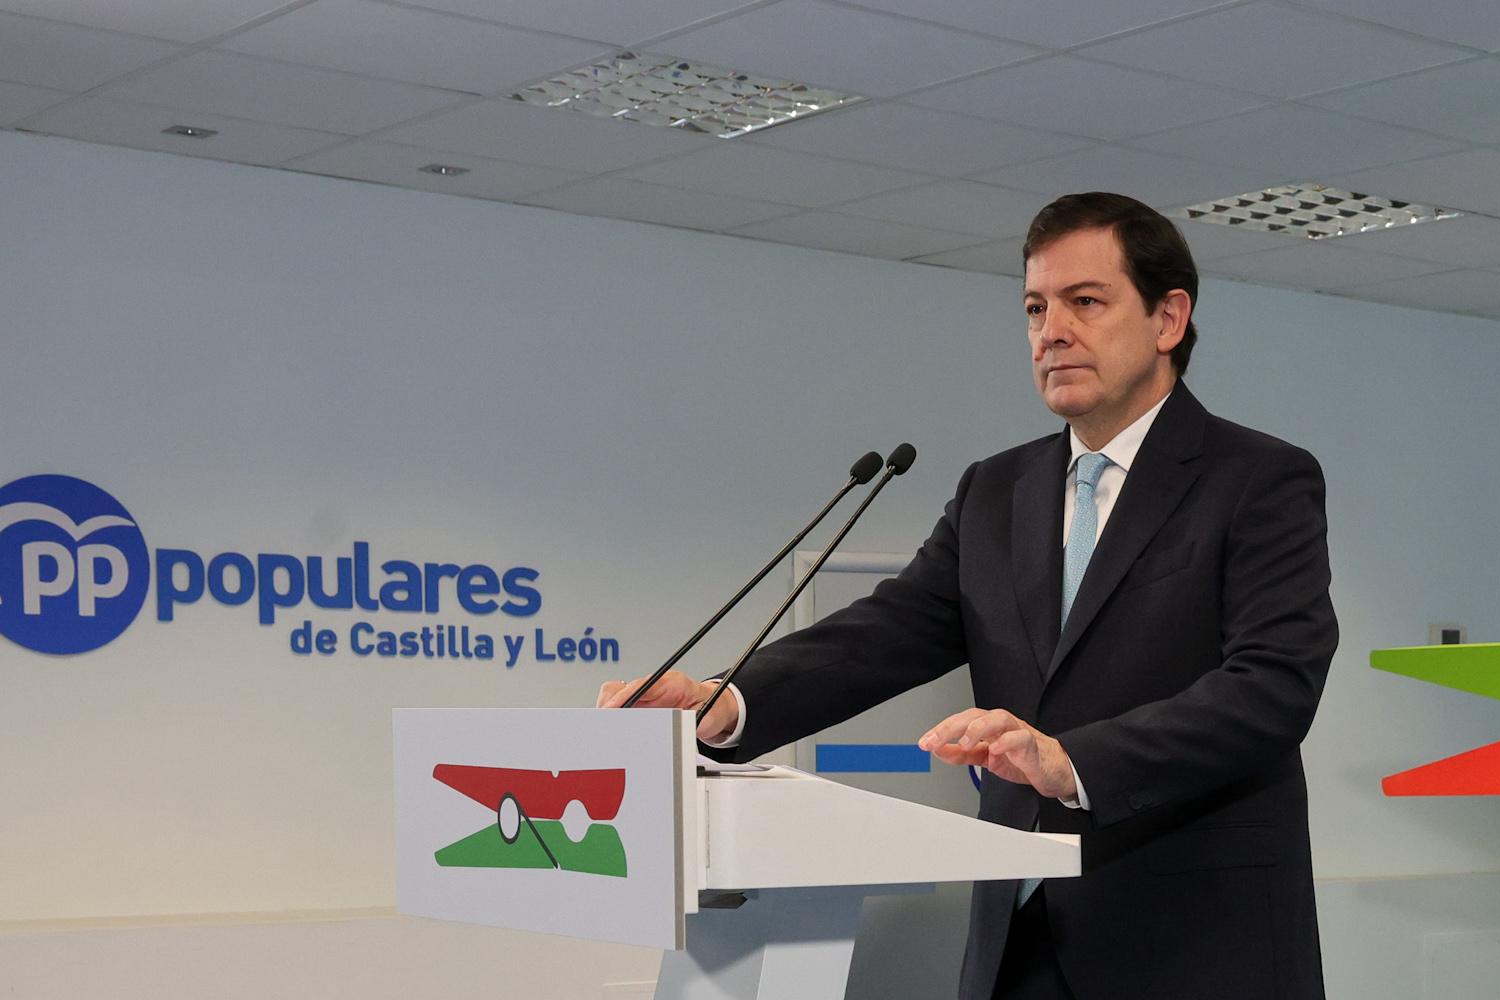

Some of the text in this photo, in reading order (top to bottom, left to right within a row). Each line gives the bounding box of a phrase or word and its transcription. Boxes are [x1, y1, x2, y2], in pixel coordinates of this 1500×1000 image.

[155, 541, 542, 626] populares
[290, 621, 620, 668] de Castilla y León
